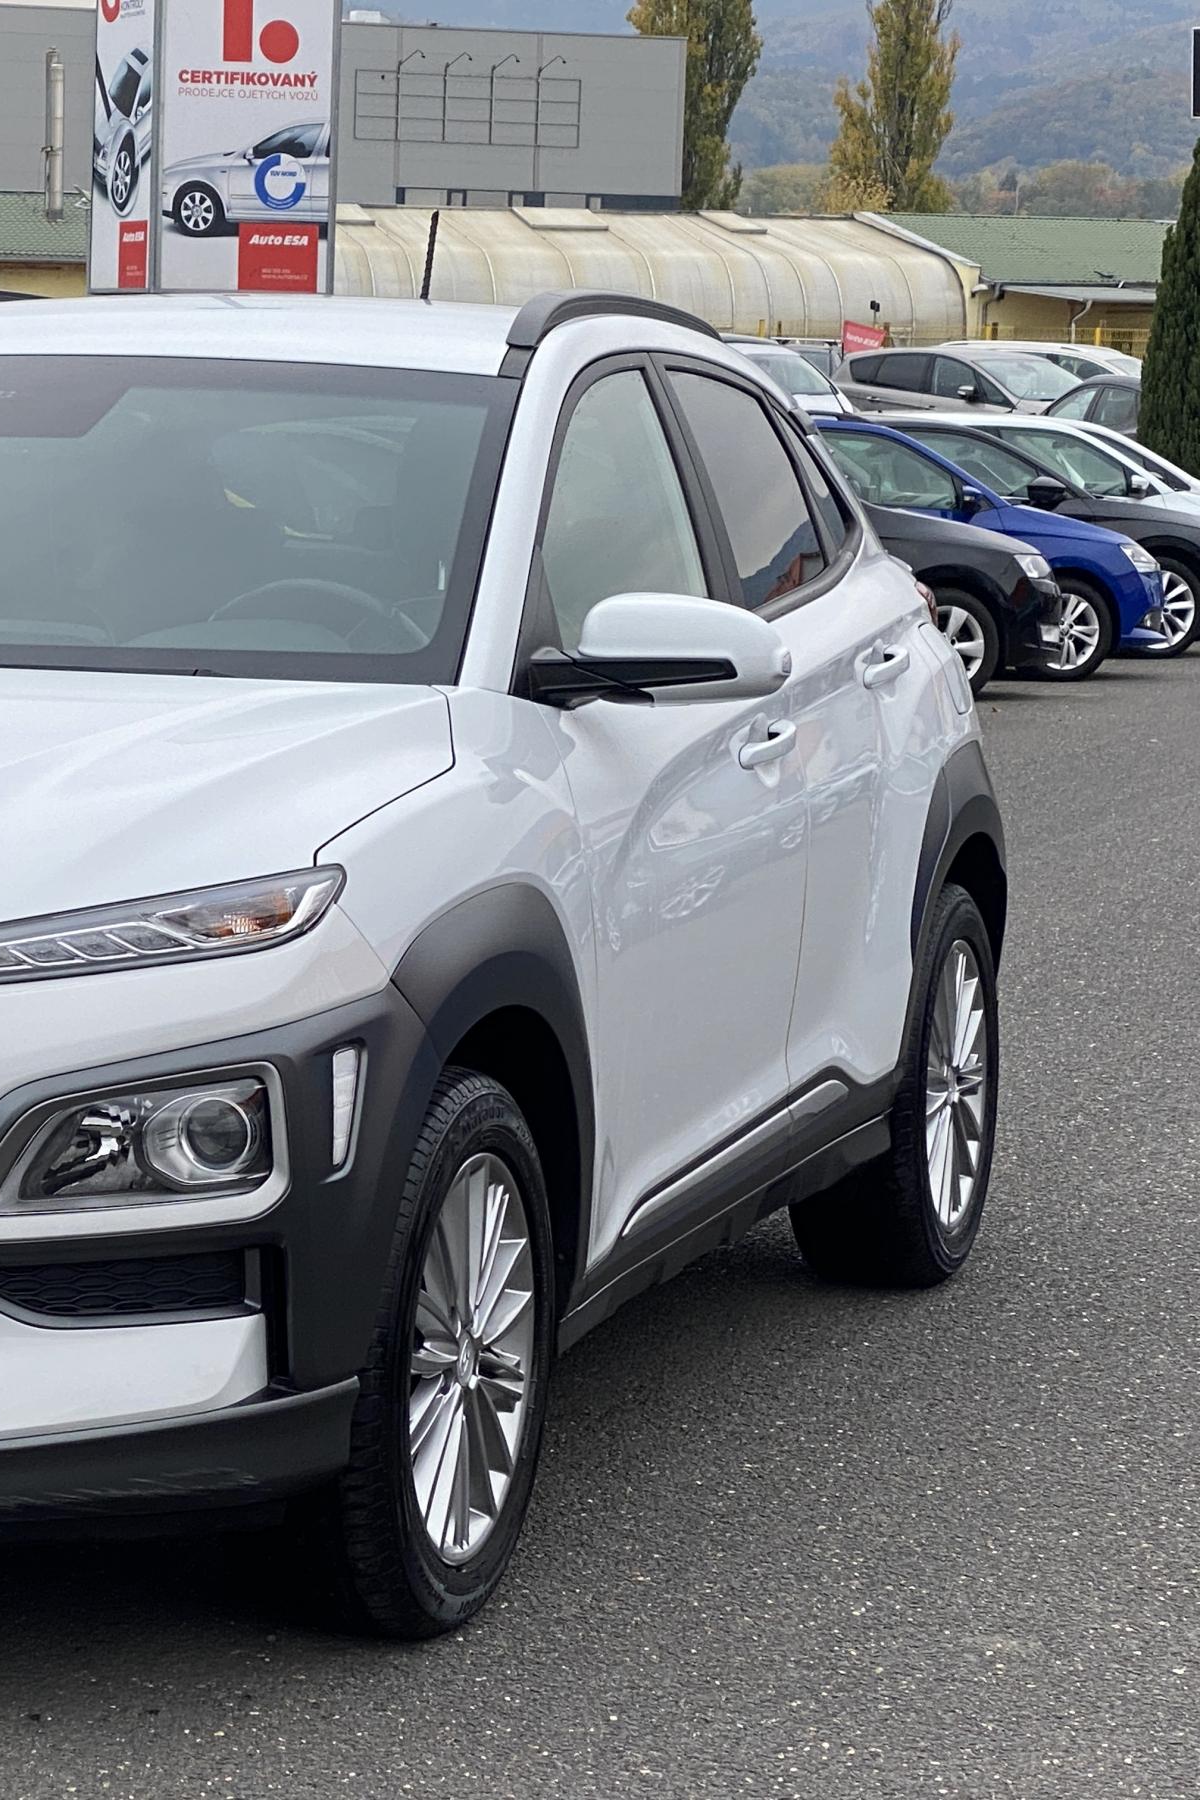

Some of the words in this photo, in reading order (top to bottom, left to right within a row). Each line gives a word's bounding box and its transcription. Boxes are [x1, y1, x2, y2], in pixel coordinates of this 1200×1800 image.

[178, 69, 318, 87] CERTIFIKOVANÝ
[178, 86, 235, 98] PRODEJCE
[237, 87, 286, 100] OJETÝCH
[288, 89, 318, 101] VOZŮ
[249, 234, 282, 246] Auto
[283, 234, 309, 246] ESA
